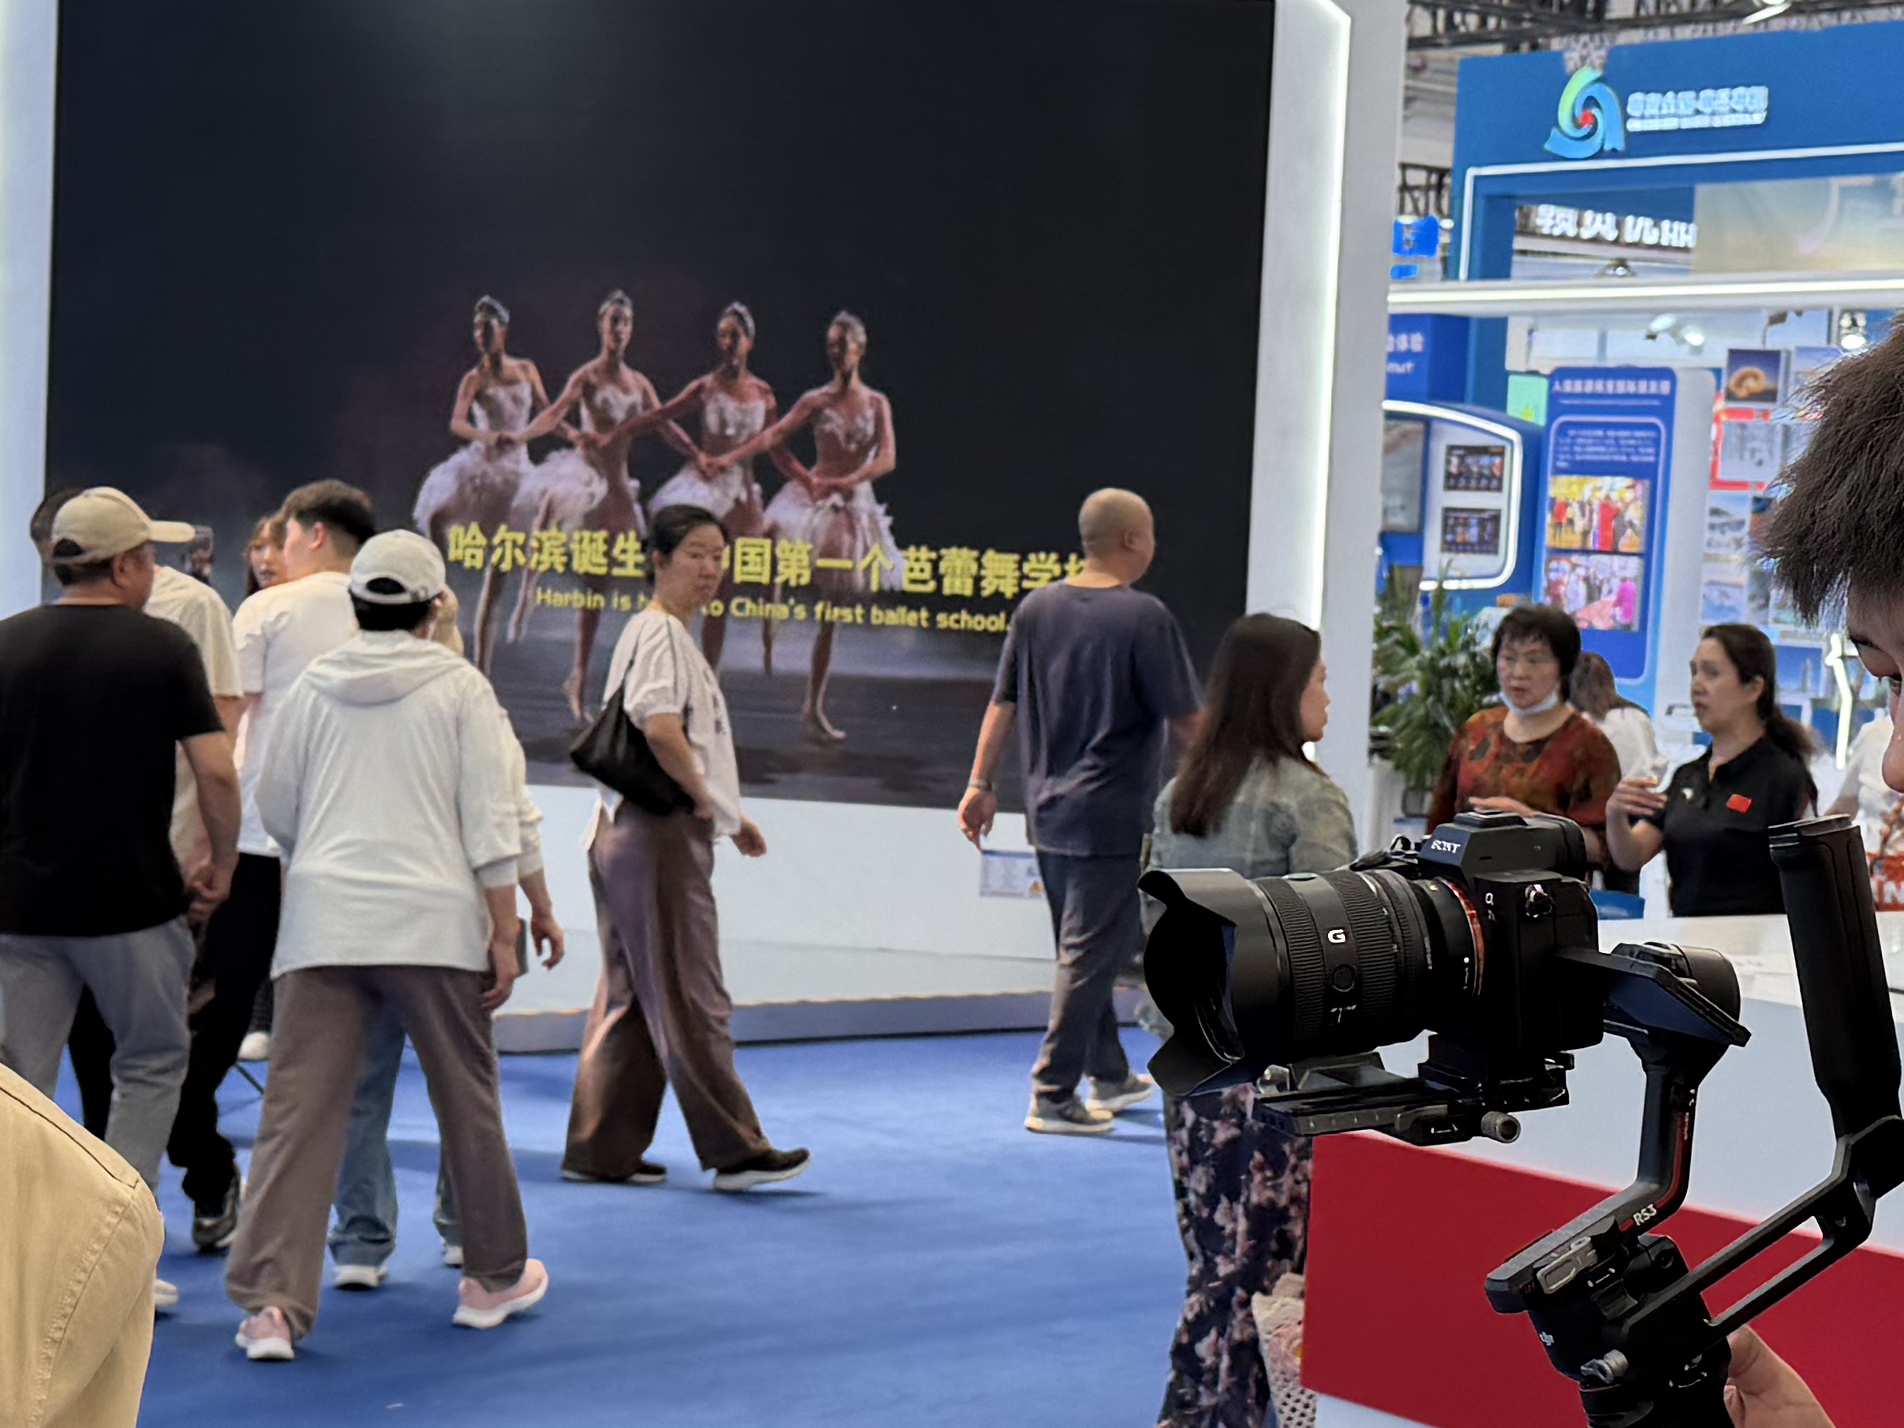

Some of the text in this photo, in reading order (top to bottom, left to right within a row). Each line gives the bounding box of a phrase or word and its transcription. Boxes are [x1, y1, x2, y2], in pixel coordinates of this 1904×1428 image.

[536, 586, 606, 610] Harbin
[612, 589, 632, 610] is
[730, 597, 807, 621] China's
[814, 600, 865, 625] first
[870, 603, 930, 628] ballet
[1327, 928, 1346, 944] G
[1632, 1202, 1658, 1227] RS3
